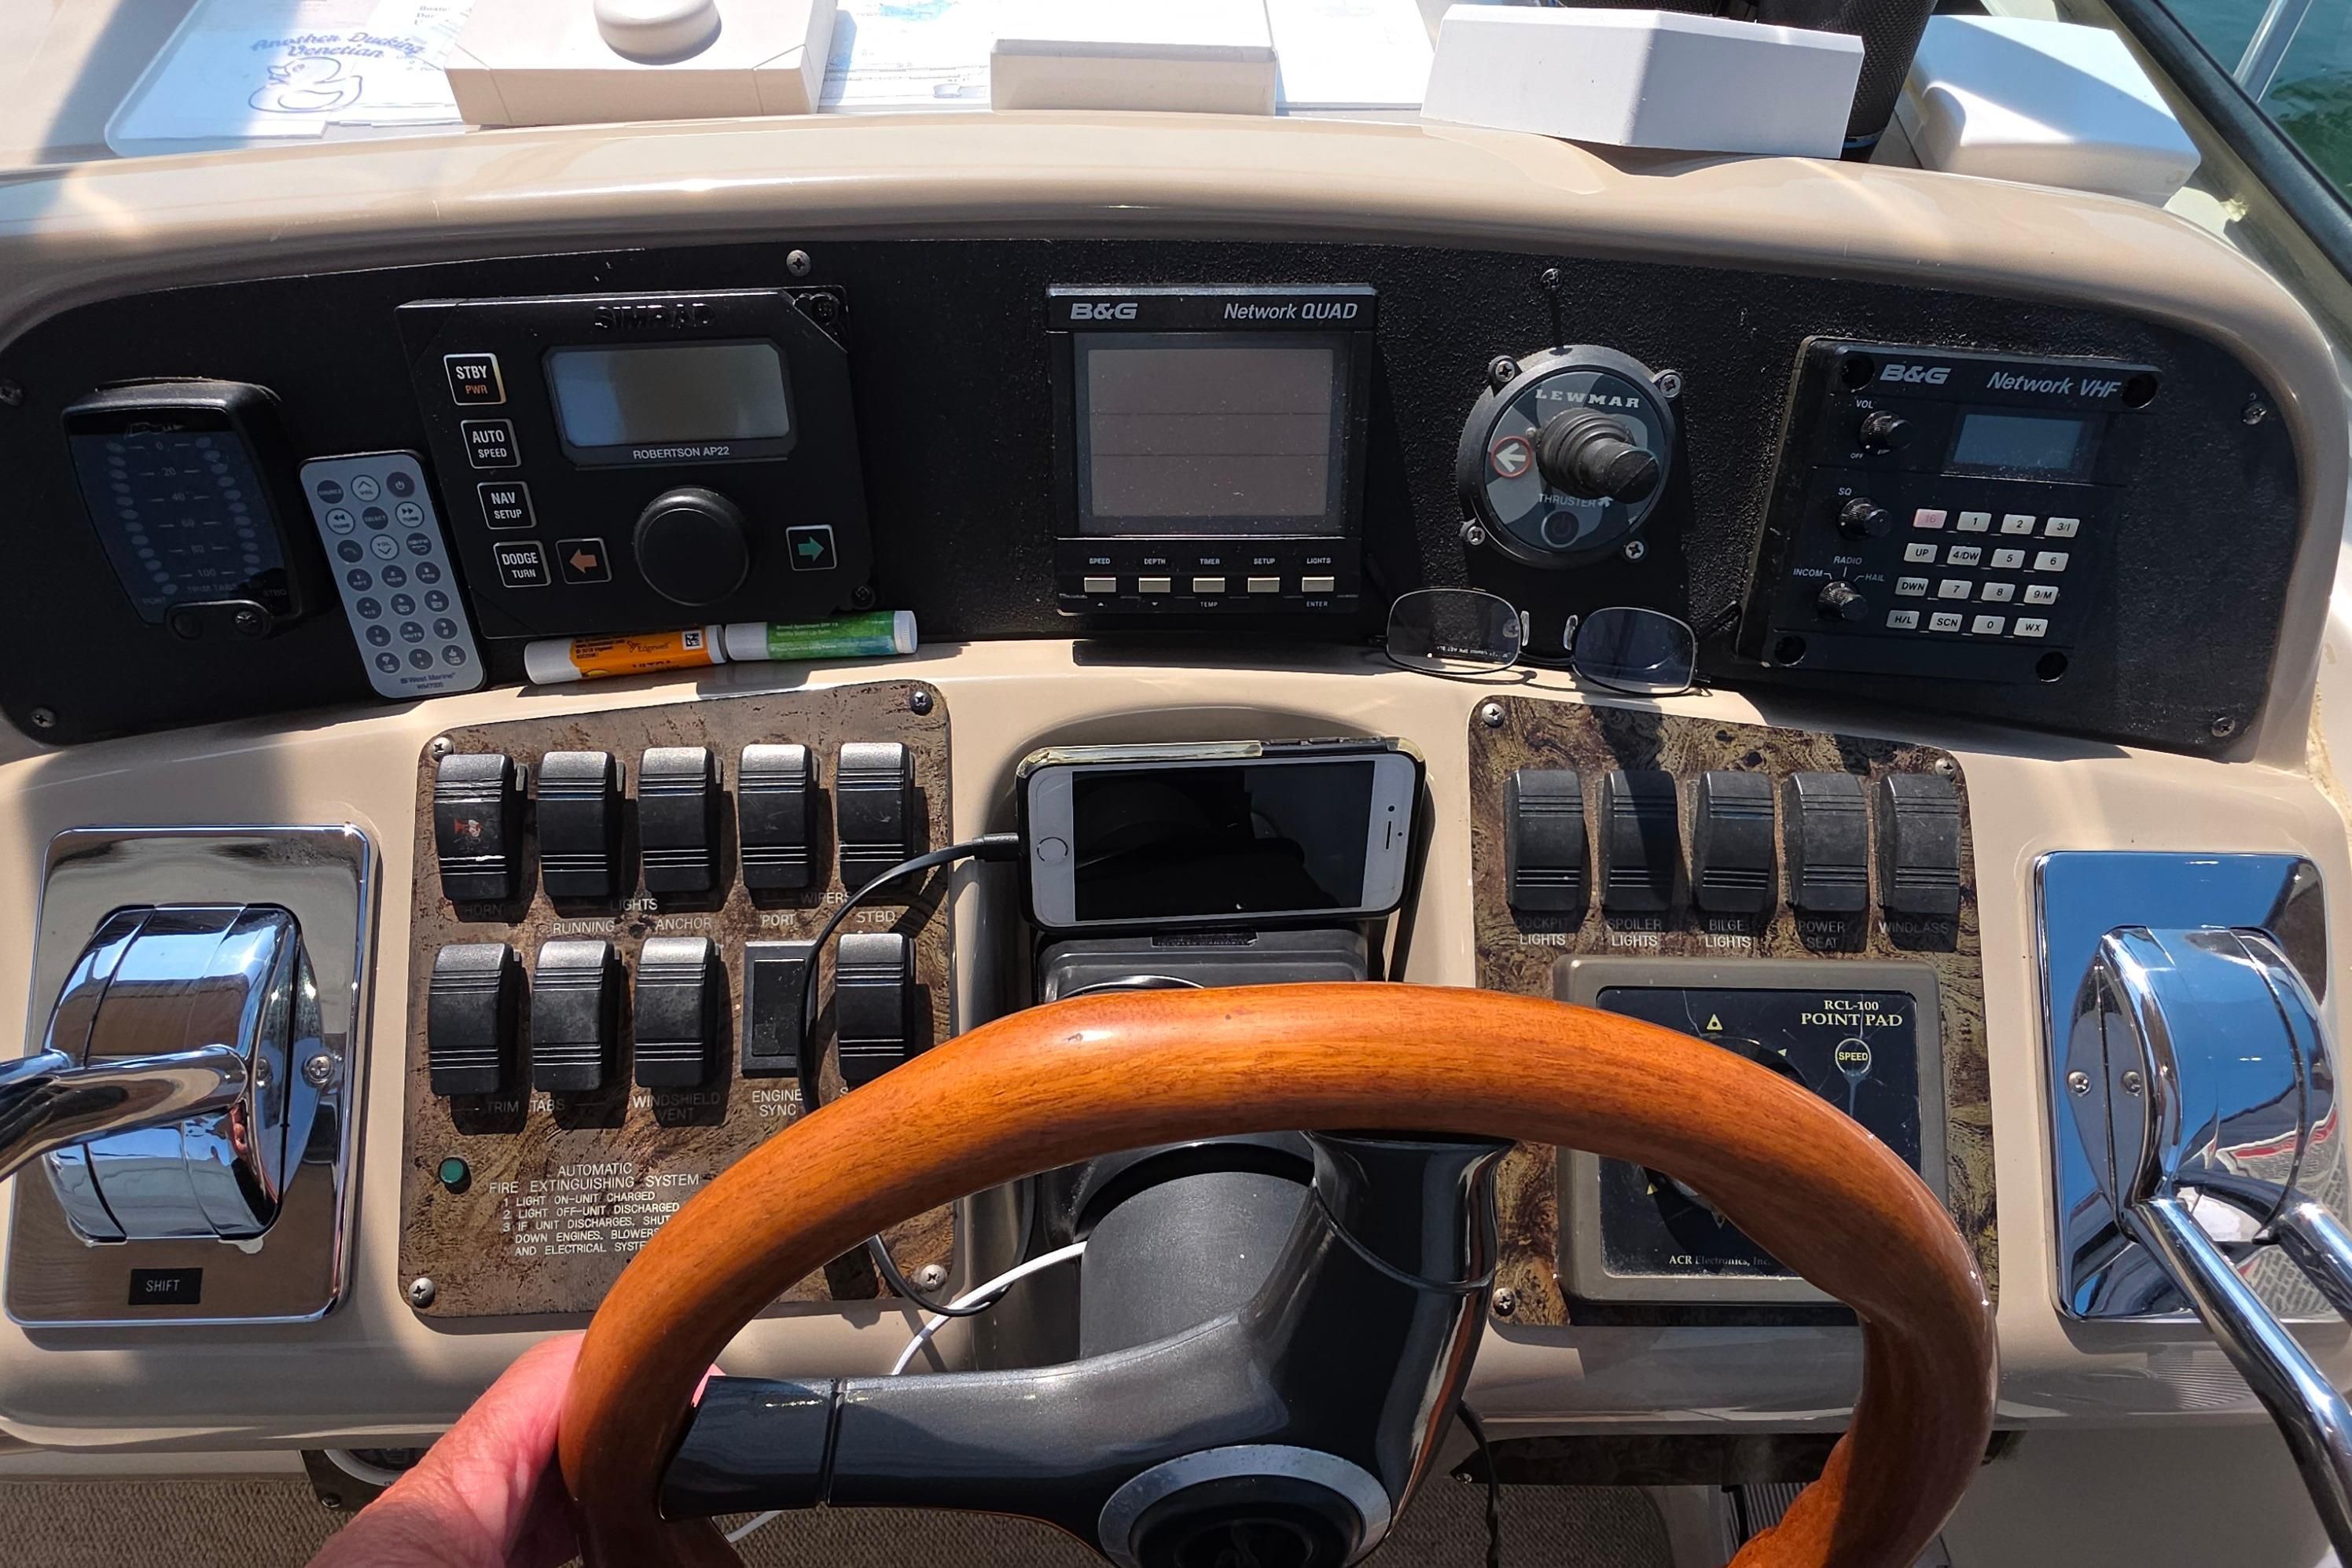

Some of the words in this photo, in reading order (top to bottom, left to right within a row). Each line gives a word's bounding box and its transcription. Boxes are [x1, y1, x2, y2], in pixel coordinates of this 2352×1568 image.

[250, 33, 340, 51] Another
[1070, 303, 1137, 320] B&G
[1224, 303, 1297, 320] Network
[1302, 303, 1358, 320] QUAD
[456, 365, 487, 380] STBY
[1880, 364, 1952, 384] B&G
[465, 384, 488, 395] PWR
[1986, 371, 2075, 395] Network
[2078, 378, 2122, 398] VHF
[1535, 388, 1641, 409] LEWMAR
[1855, 399, 1874, 409] VOL
[472, 430, 505, 444] AUTO
[478, 448, 507, 458] SPEED
[633, 447, 700, 461] ROBERTSON
[703, 446, 729, 457] AP22
[162, 467, 176, 477] 20
[171, 492, 186, 502] 40
[1838, 487, 1853, 497] SQ
[491, 492, 516, 505] NAV
[1538, 494, 1597, 508] THRUSTER
[494, 509, 522, 520] SETUP
[1924, 514, 1937, 524] 16
[1972, 516, 1978, 526] 1
[2016, 520, 2023, 529] 2
[502, 553, 538, 565] DODGE
[1915, 549, 1929, 557] UP
[1953, 551, 1979, 561] 4/DW
[2006, 554, 2013, 563] 5
[1833, 556, 1862, 565] RADIO
[2049, 556, 2057, 566] 6
[197, 567, 217, 578] 100
[511, 569, 536, 578] TURN
[1793, 568, 1824, 577] INCOM
[1864, 574, 1885, 582] HAIL
[1901, 582, 1924, 591] DWN
[1953, 585, 1960, 593] 7
[1996, 588, 2004, 597] 8
[2034, 590, 2052, 600] 9/M
[1894, 615, 1913, 625] H/L
[1936, 618, 1958, 627] SCN
[2024, 623, 2041, 633] WX
[409, 674, 426, 684] West
[801, 891, 852, 904] WIPERS
[463, 904, 505, 916] HORN
[611, 899, 658, 911] LIGHTS
[762, 913, 796, 927] PORT
[857, 911, 895, 923] STBD
[1516, 917, 1570, 929] COCKPIT
[553, 920, 615, 935] RUNNING
[656, 917, 712, 931] ANCHOR
[1610, 918, 1663, 931] SPOILER
[1709, 920, 1744, 931] BILGE
[1798, 920, 1845, 933] POWER
[1879, 921, 1949, 935] WINDLASS
[1520, 934, 1566, 946] LIGHTS
[1611, 935, 1658, 947] LIGHTS
[1705, 936, 1751, 948] LIGHTS
[1806, 936, 1838, 949] SEAT
[1824, 1001, 1880, 1011] RCL-100
[1801, 1012, 1860, 1026] POINT
[1865, 1013, 1903, 1026] PAD
[1838, 1052, 1869, 1062] SPEED
[633, 1092, 721, 1108] WINDSHIELD
[752, 1089, 803, 1103] ENGINE
[487, 1101, 519, 1113] TRIM
[531, 1099, 565, 1112] TABS
[759, 1103, 796, 1117] SYNC
[659, 1107, 695, 1122] VENT
[557, 1162, 632, 1177] AUTOMATIC
[489, 1182, 519, 1195] FIRE
[530, 1177, 635, 1193] EXTINGUISHING
[645, 1173, 700, 1188] SYSTEM
[503, 1198, 509, 1207] 1
[516, 1195, 546, 1207] LIGHT
[554, 1193, 599, 1205] ON-UNIT
[607, 1191, 656, 1203] CHARGED
[503, 1210, 511, 1220] 2
[518, 1208, 549, 1219] LIGHT
[557, 1205, 606, 1217] OFF-UNIT
[614, 1203, 680, 1214] DISCHARGED
[503, 1222, 511, 1232] 3
[518, 1221, 528, 1231] IF
[536, 1219, 559, 1231] UNIT
[515, 1232, 548, 1243] DOWN
[515, 1246, 537, 1256] AND
[545, 1243, 607, 1255] ELECTRICAL
[1669, 1255, 1692, 1265] ACR
[1696, 1256, 1751, 1267] Electronics,
[145, 1280, 181, 1292] SHIFT
